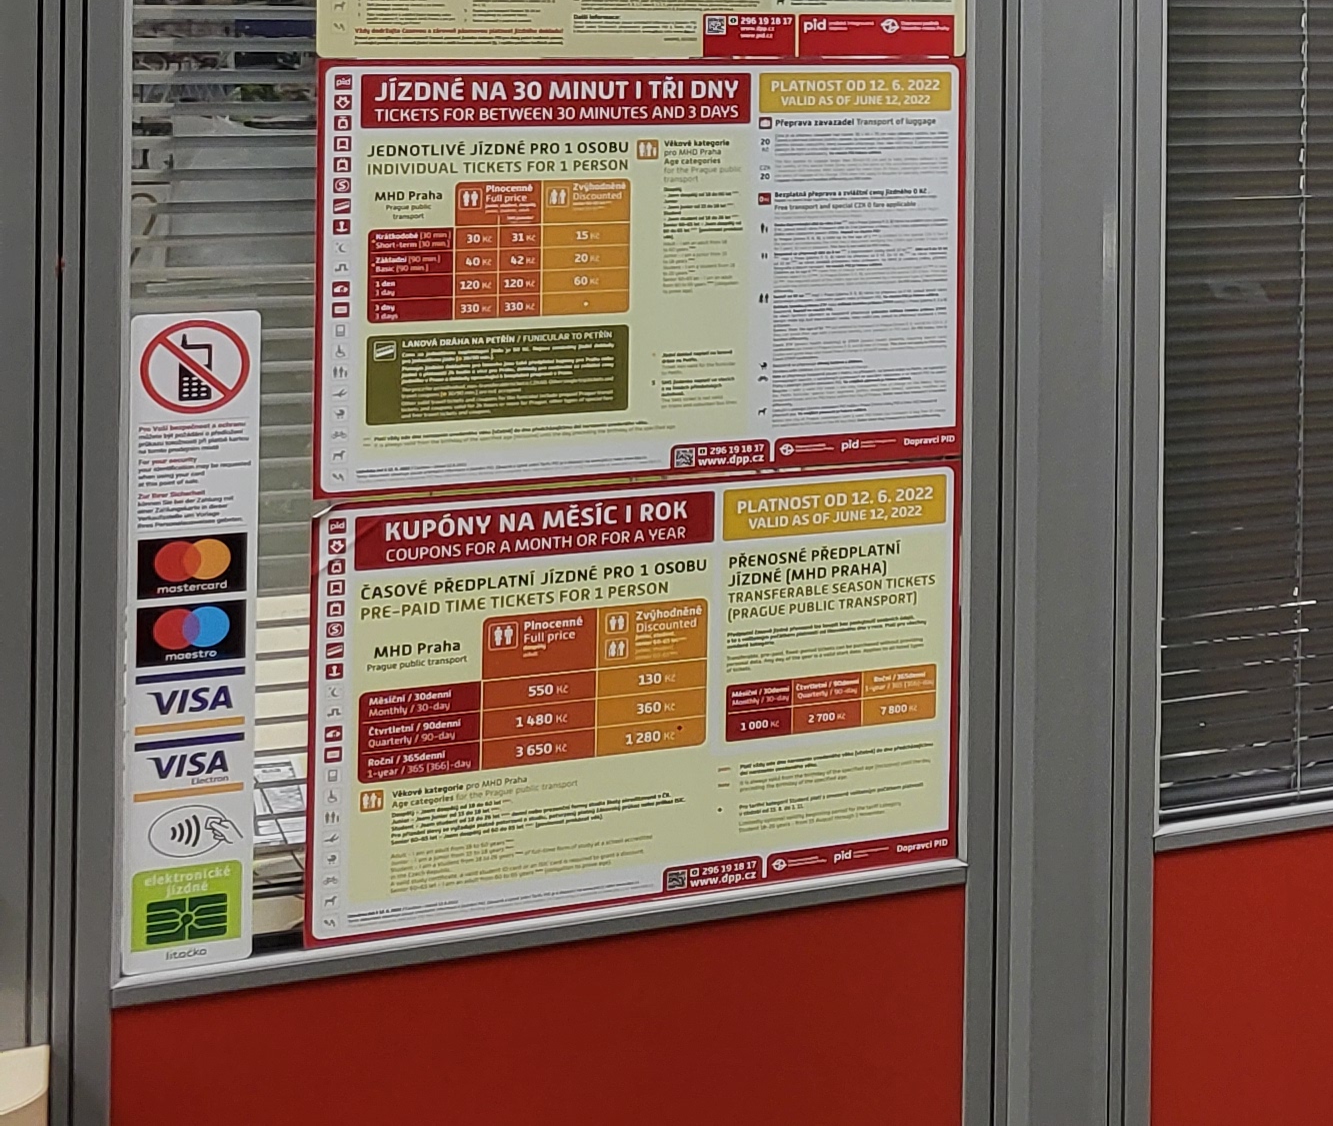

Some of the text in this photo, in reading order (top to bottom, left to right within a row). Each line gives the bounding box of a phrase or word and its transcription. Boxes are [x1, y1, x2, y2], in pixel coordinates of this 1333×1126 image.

[740, 17, 792, 25] 296 19 18 17
[375, 75, 738, 102] JÍZDNÉ NA 30 MINUT I TŘI DNY
[771, 78, 940, 92] PLATNOST OD 12. 6. 2022
[375, 105, 738, 121] TICKETS FOR BETWEEN 30 MINUTES AND 3 DAYS
[367, 141, 629, 157] JEDNOTLIVÉ JÍZDNÉ PRO 1 OSOBU
[375, 191, 442, 201] MHD Praha
[698, 454, 764, 466] www.dpp.cz
[386, 501, 687, 541] KUPÓNY NA MĚSÍC I ROK
[386, 526, 686, 562] COUPONS FOR A MONTH OR FOR A YEAR
[156, 581, 228, 594] mastercard
[728, 575, 935, 603] TRANSFERABLE SEASON TICKETS
[524, 616, 583, 631] Plnocenné
[524, 629, 575, 643] Full price
[165, 649, 217, 661] maestro
[366, 655, 467, 672] Prague public transport
[528, 684, 553, 696] 550
[146, 686, 233, 715] VISA
[146, 750, 229, 779] VISA
[191, 775, 229, 785] Electron
[897, 838, 948, 854] Dopravci PID
[144, 866, 230, 886] elektronické
[166, 881, 209, 899] jízdné
